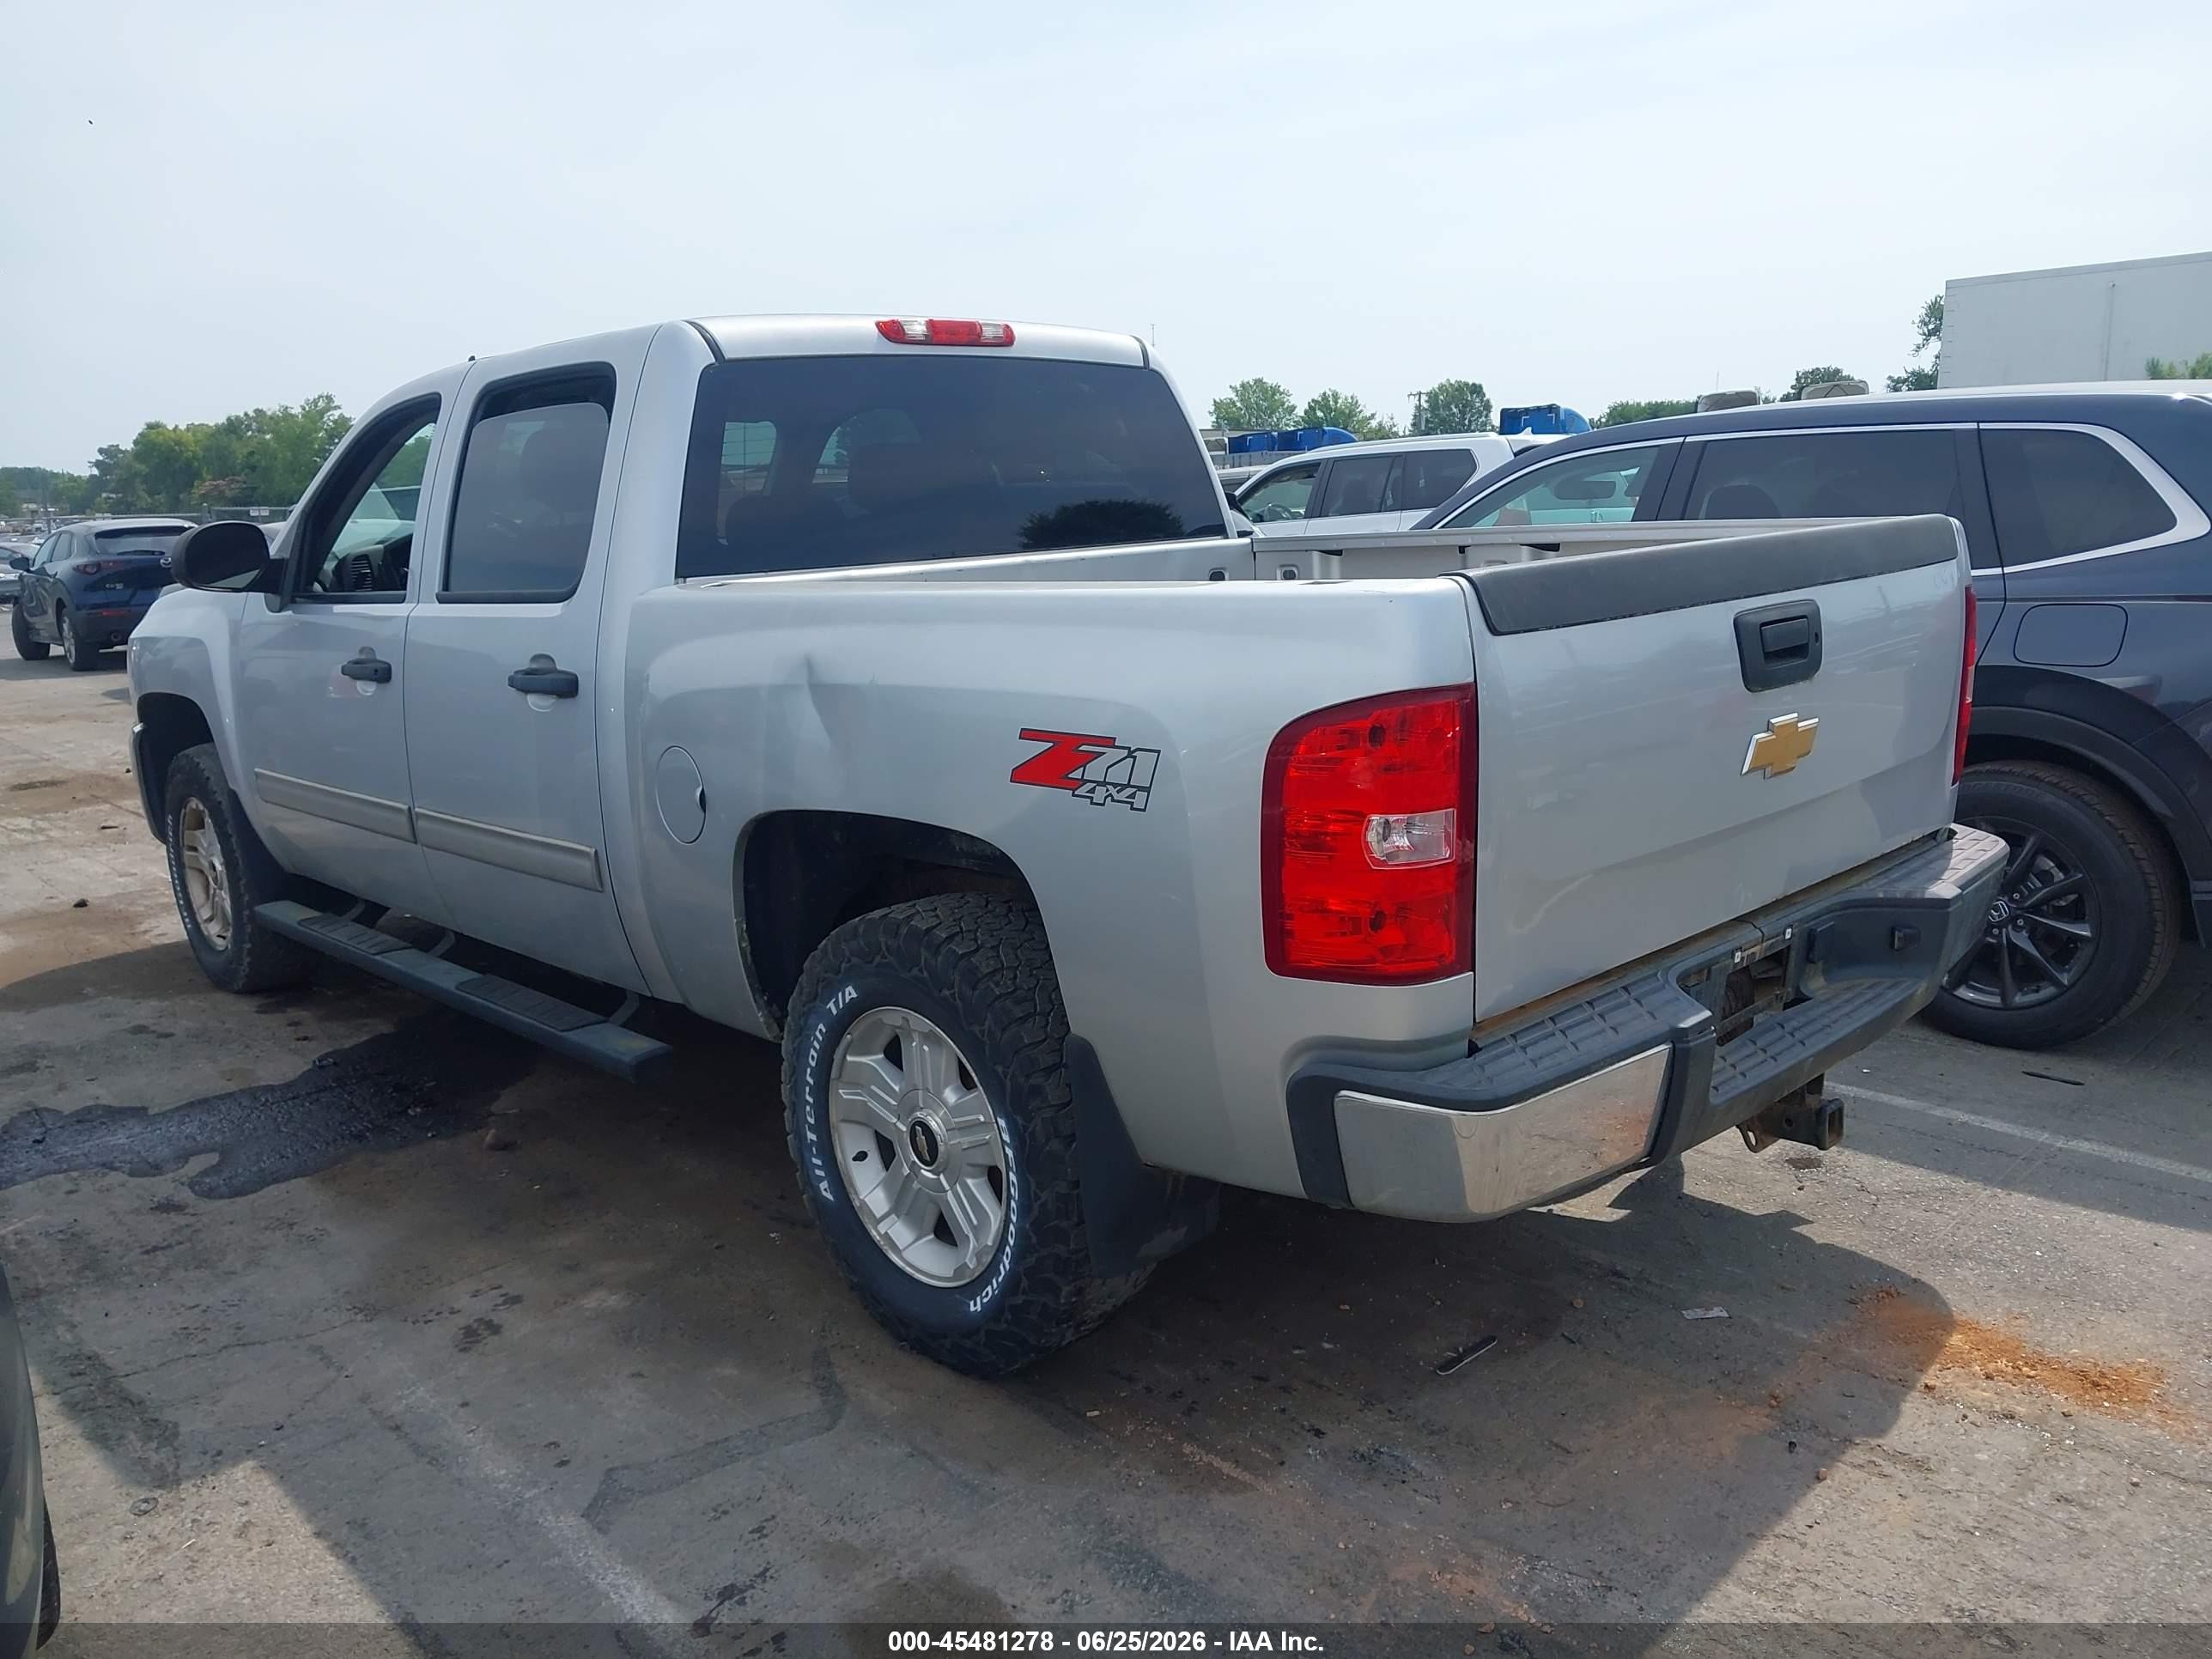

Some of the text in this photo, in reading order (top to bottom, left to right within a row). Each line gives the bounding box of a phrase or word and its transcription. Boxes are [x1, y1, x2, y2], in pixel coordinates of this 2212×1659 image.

[1009, 727, 1162, 792] Z71
[802, 985, 859, 1202] All-Terrain T/A
[969, 1117, 1019, 1314] BFGoodrich
